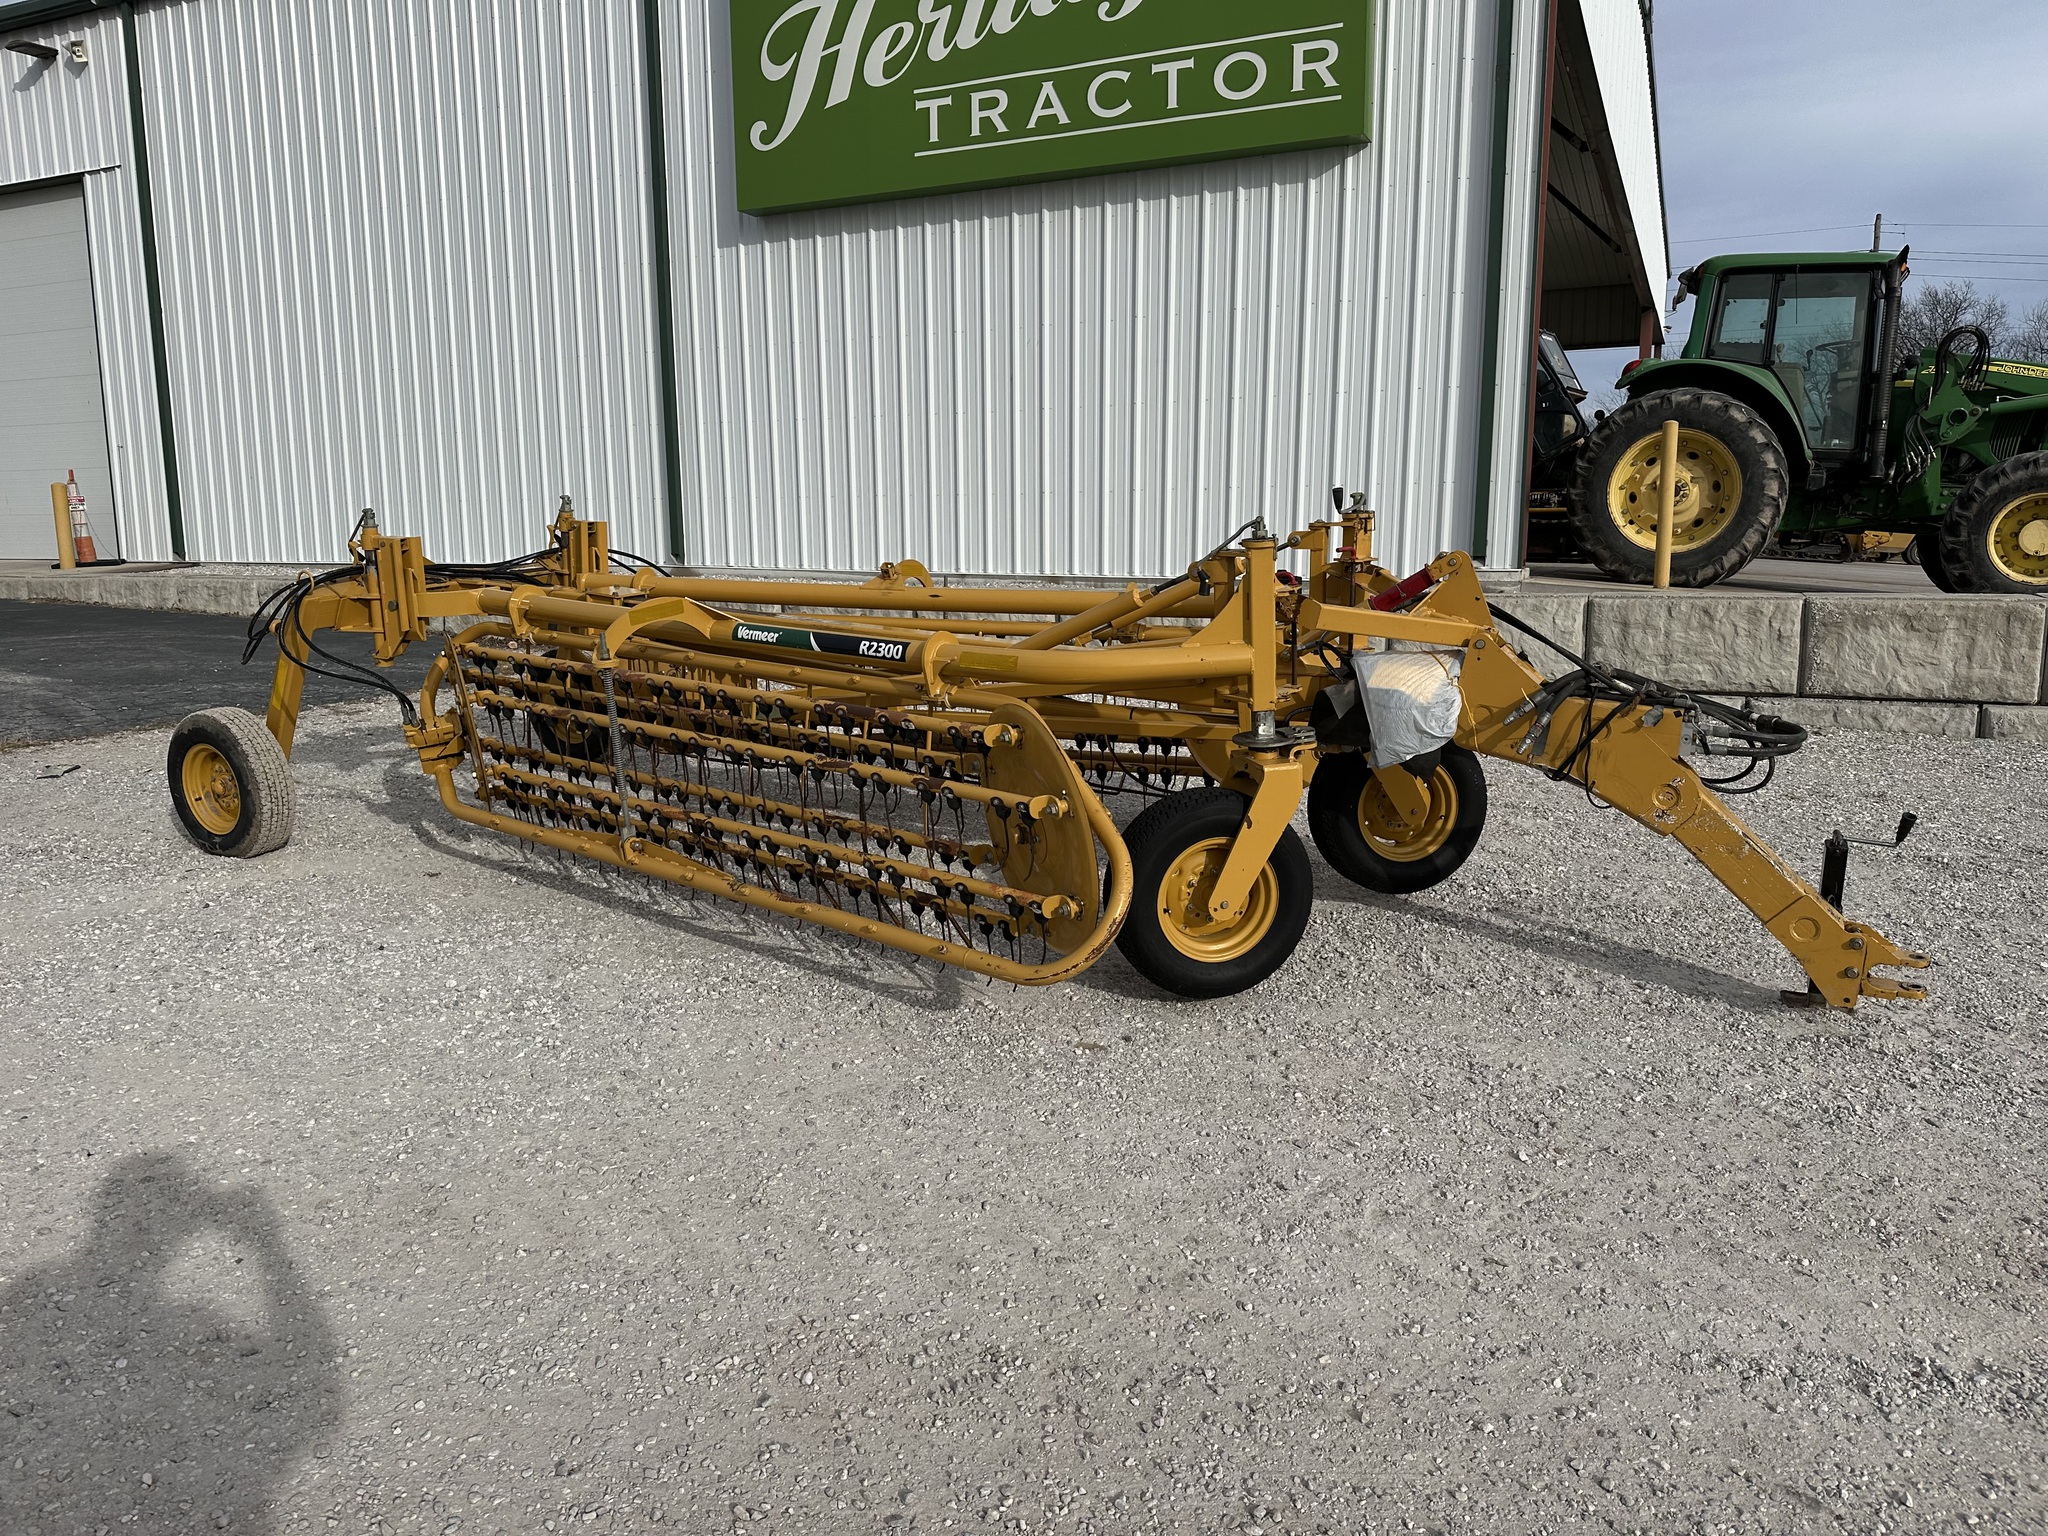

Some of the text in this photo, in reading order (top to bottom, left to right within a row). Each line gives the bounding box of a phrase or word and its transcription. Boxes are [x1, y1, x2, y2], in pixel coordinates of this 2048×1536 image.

[915, 38, 1340, 143] TRACTOR
[737, 626, 779, 643] Vermeer
[858, 640, 903, 660] R2300
